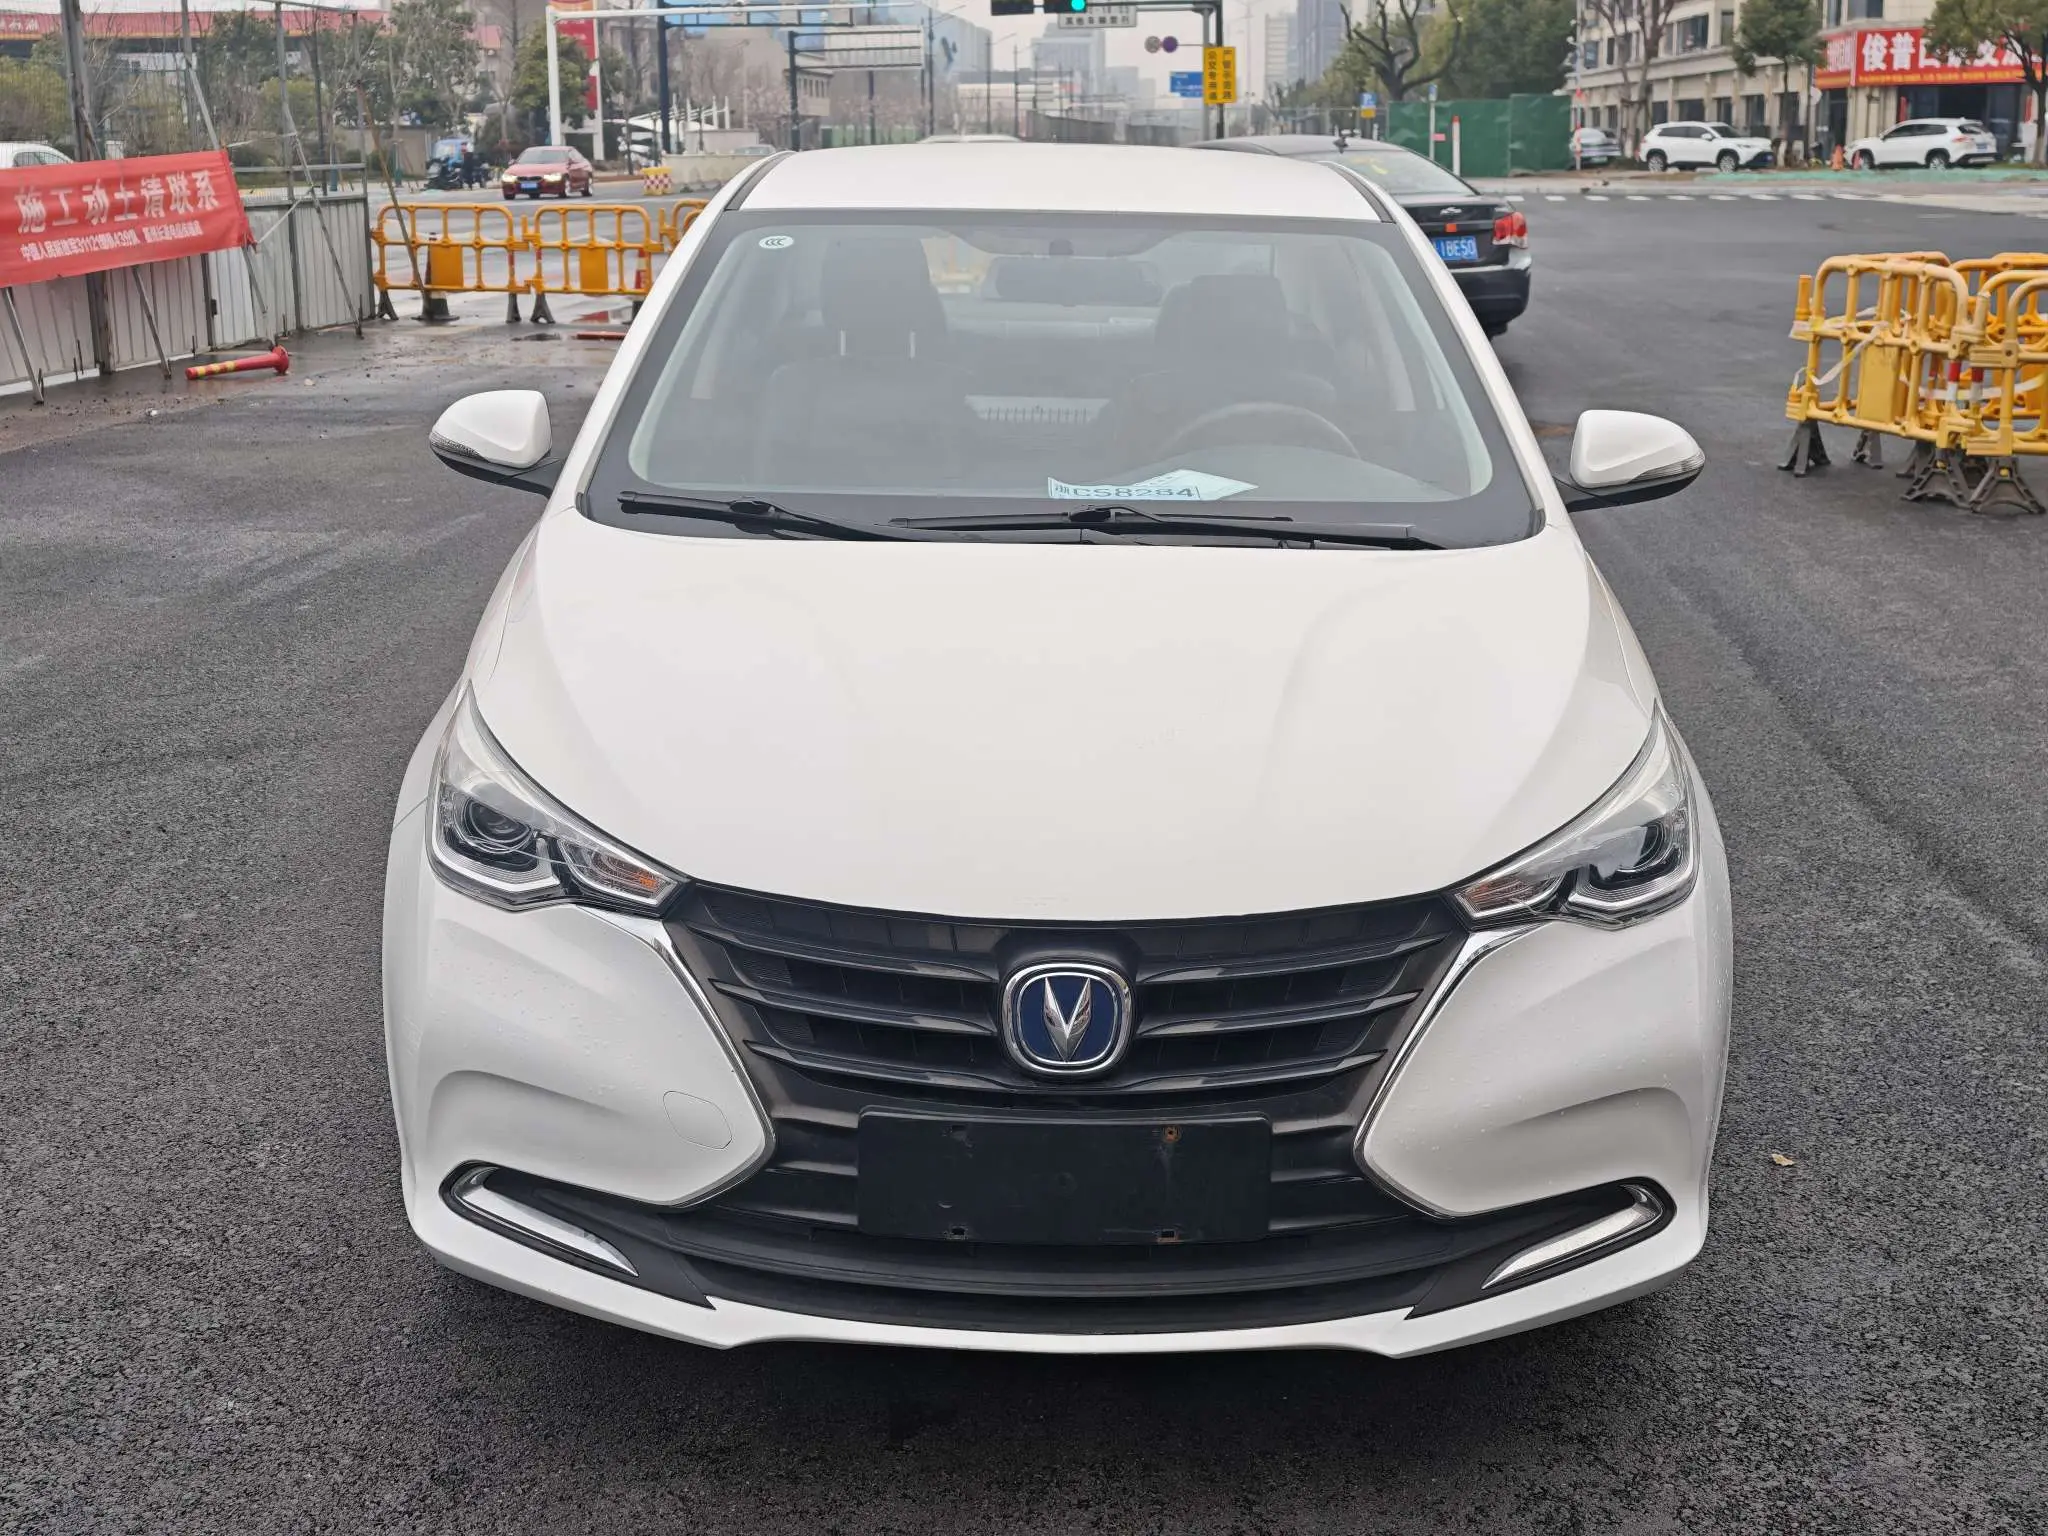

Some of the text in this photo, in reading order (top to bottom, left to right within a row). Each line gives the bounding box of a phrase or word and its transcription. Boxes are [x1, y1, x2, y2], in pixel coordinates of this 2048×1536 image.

[14, 169, 219, 234] 施工动土请联系
